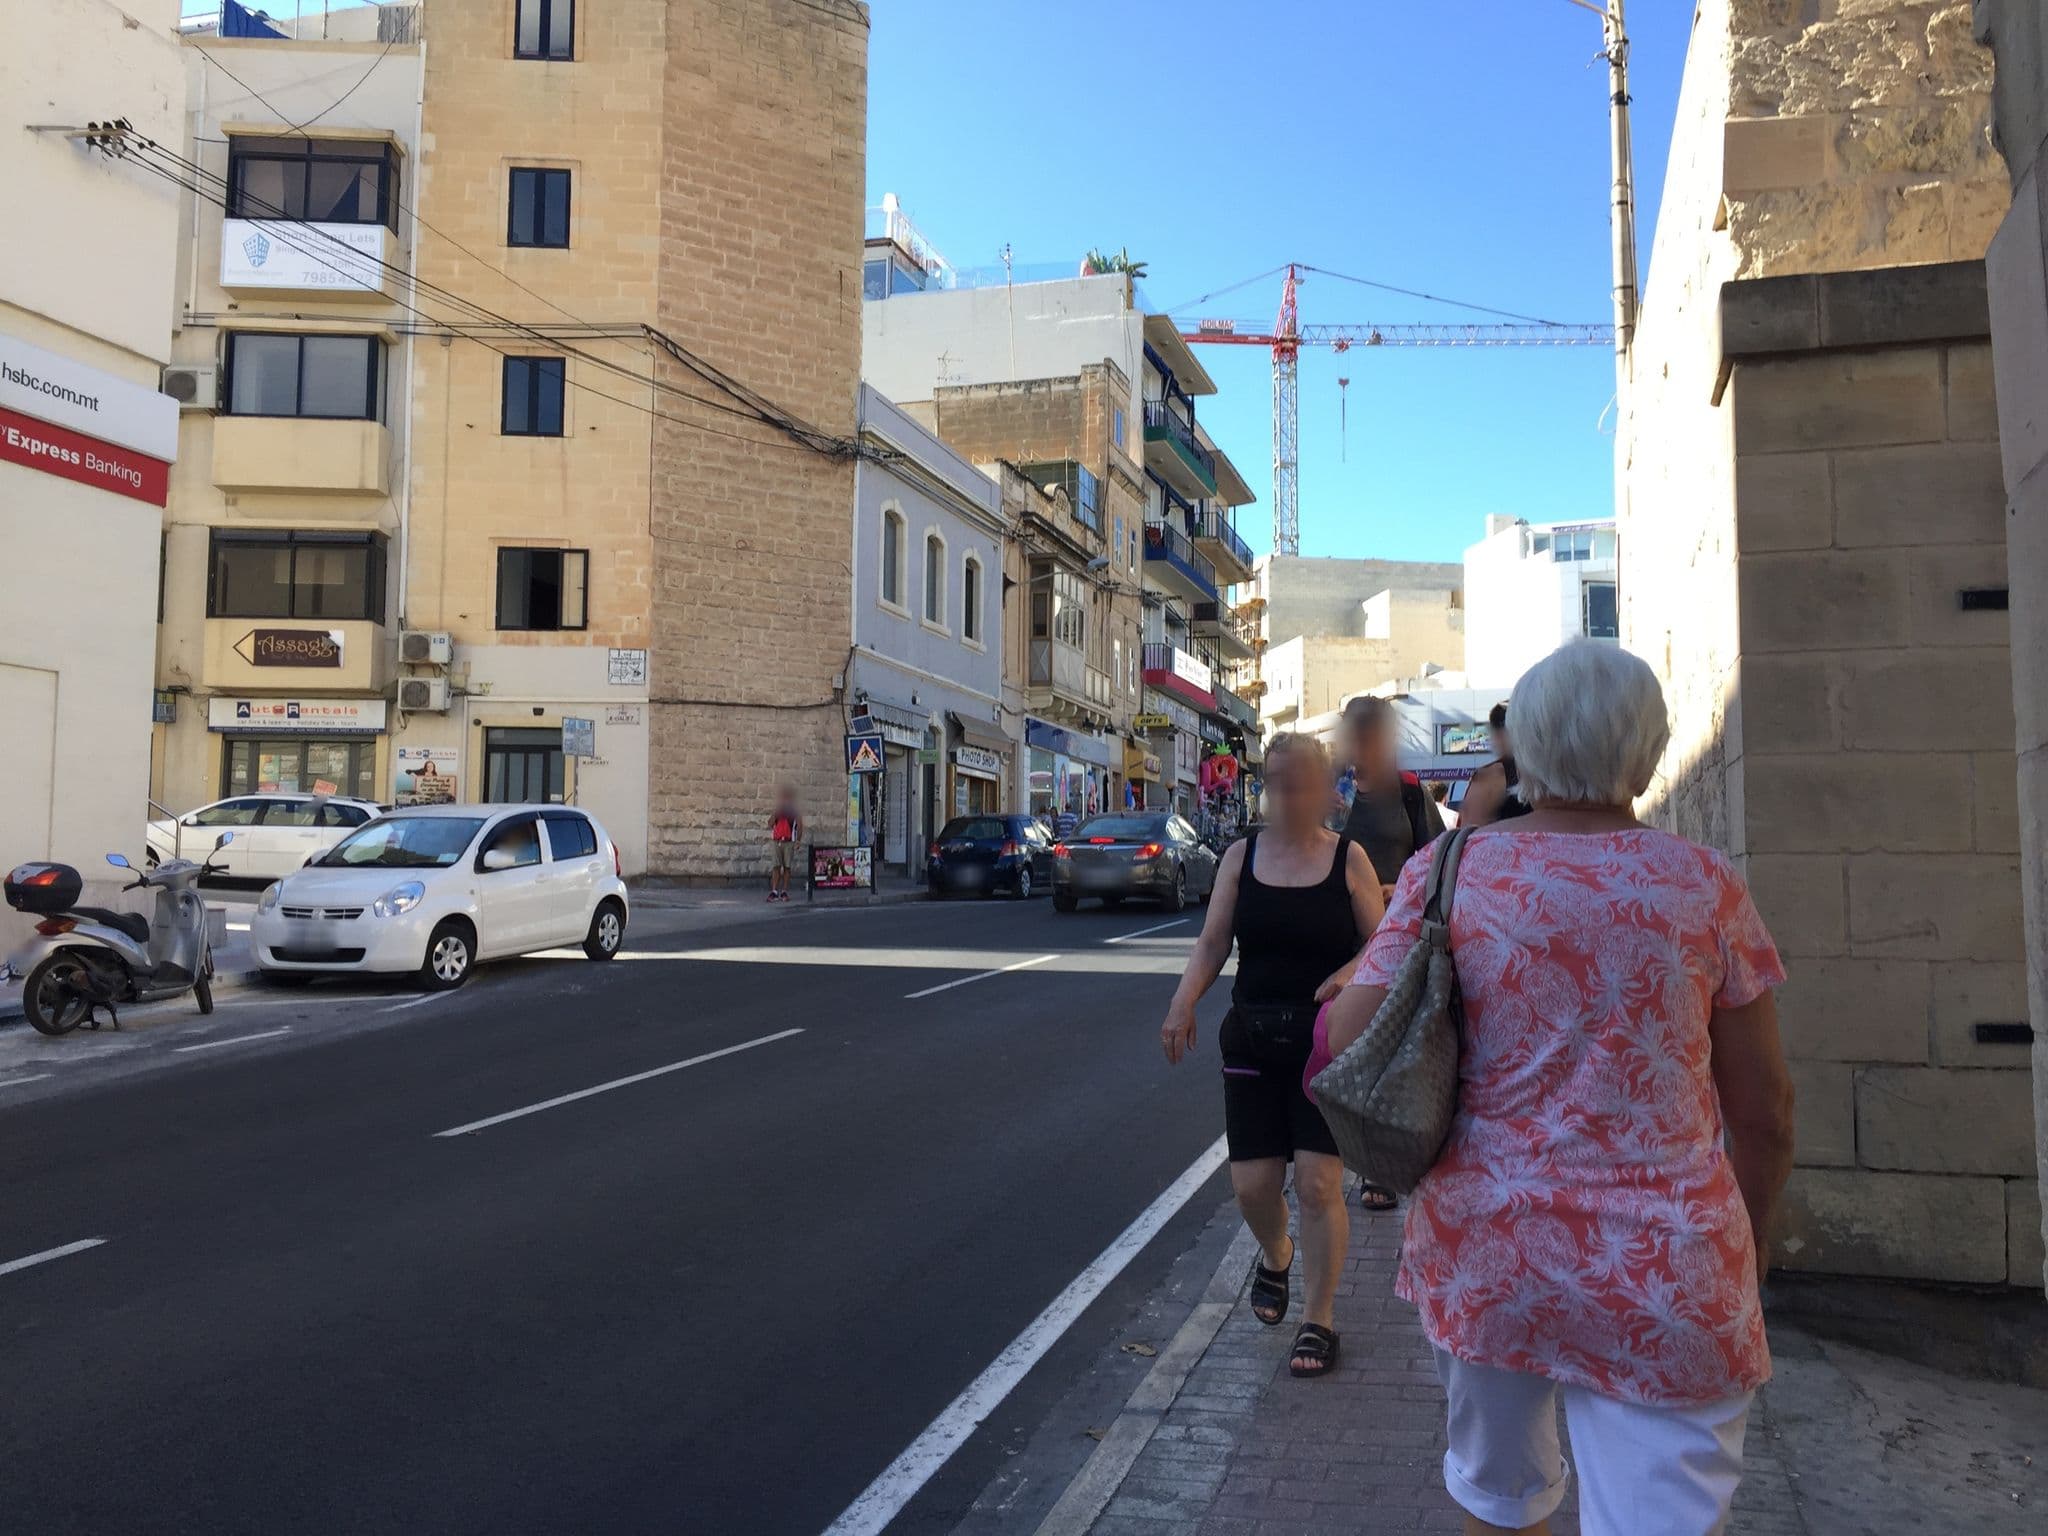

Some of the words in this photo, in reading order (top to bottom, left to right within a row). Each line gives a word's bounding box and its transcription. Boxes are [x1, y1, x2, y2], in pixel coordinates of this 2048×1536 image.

[1, 361, 99, 412] hsbc.com.mt
[7, 427, 80, 465] Express
[85, 452, 142, 488] Banking
[287, 702, 358, 719] Rentals
[961, 748, 981, 764] PHOTO
[982, 754, 996, 768] SHOP
[1416, 769, 1431, 778] Your
